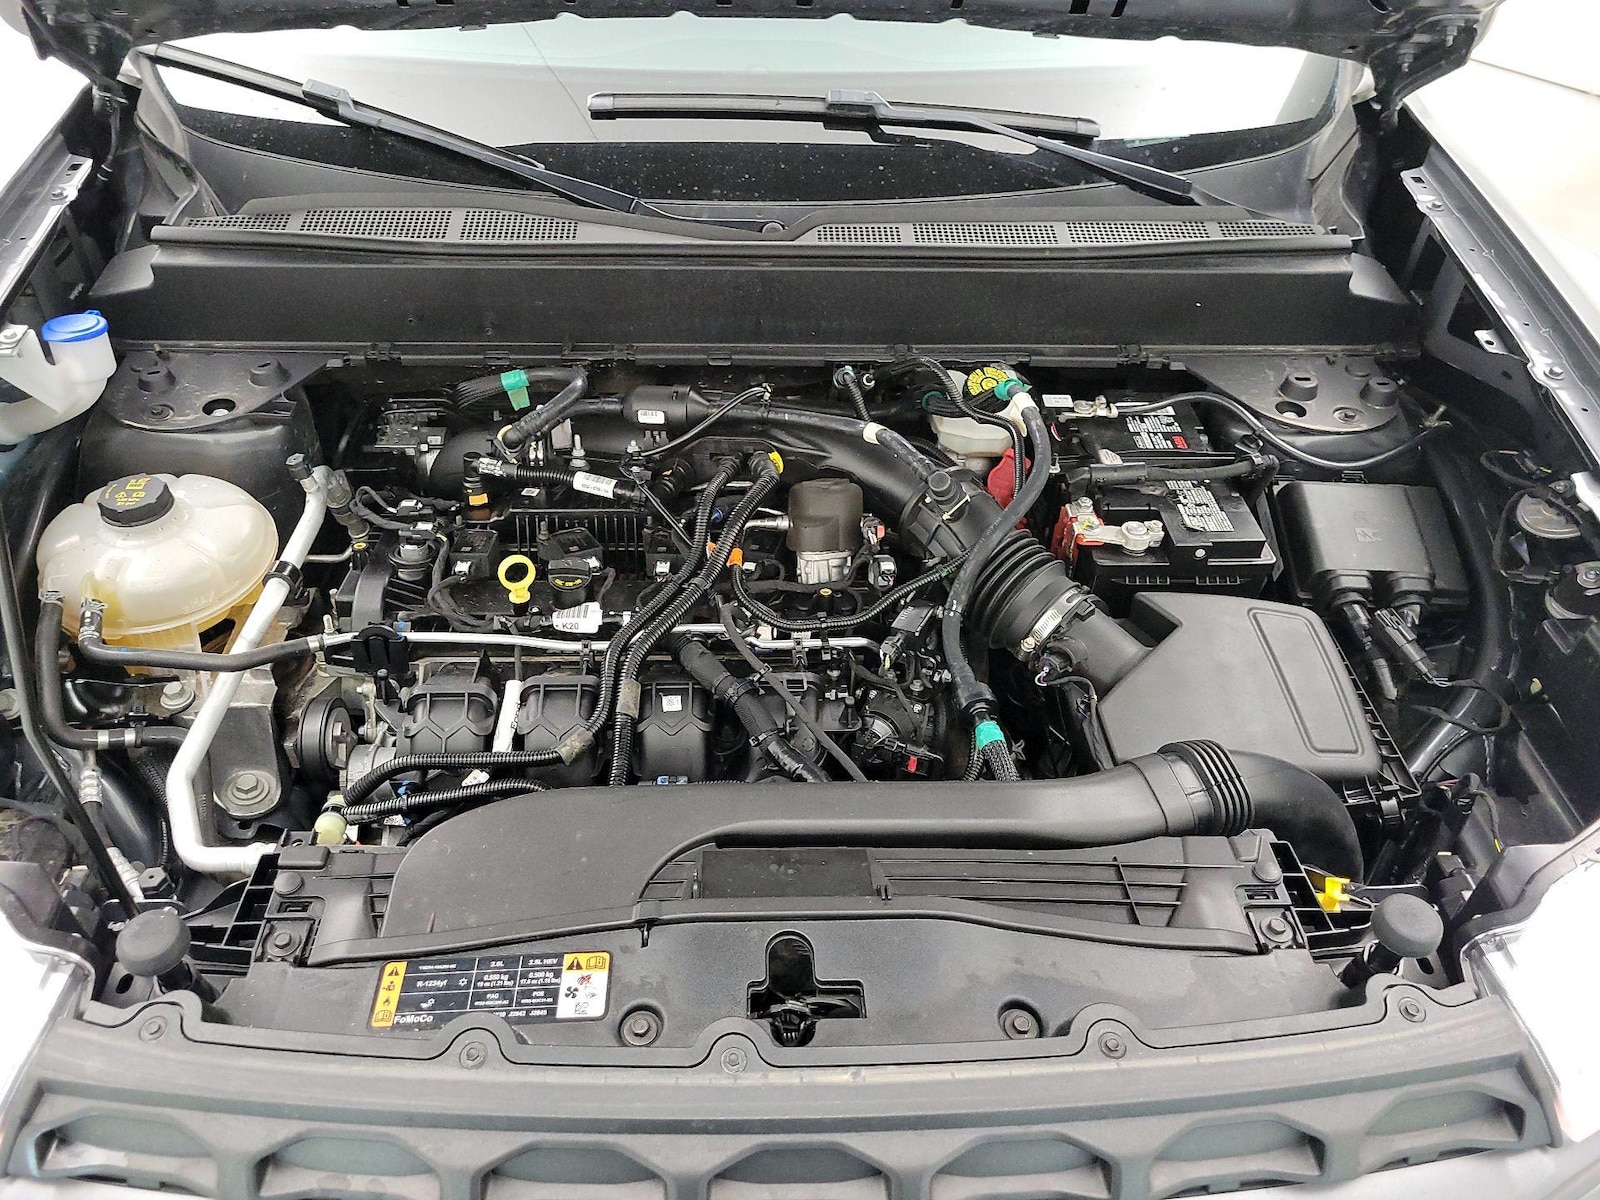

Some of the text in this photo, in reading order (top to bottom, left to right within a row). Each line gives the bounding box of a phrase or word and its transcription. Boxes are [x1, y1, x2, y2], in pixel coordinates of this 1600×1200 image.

[561, 622, 580, 630] K20
[543, 957, 559, 965] HEV
[500, 973, 509, 981] kg
[545, 971, 554, 979] kg
[416, 979, 448, 988] R-1234yf
[394, 1014, 434, 1024] FoMoCo
